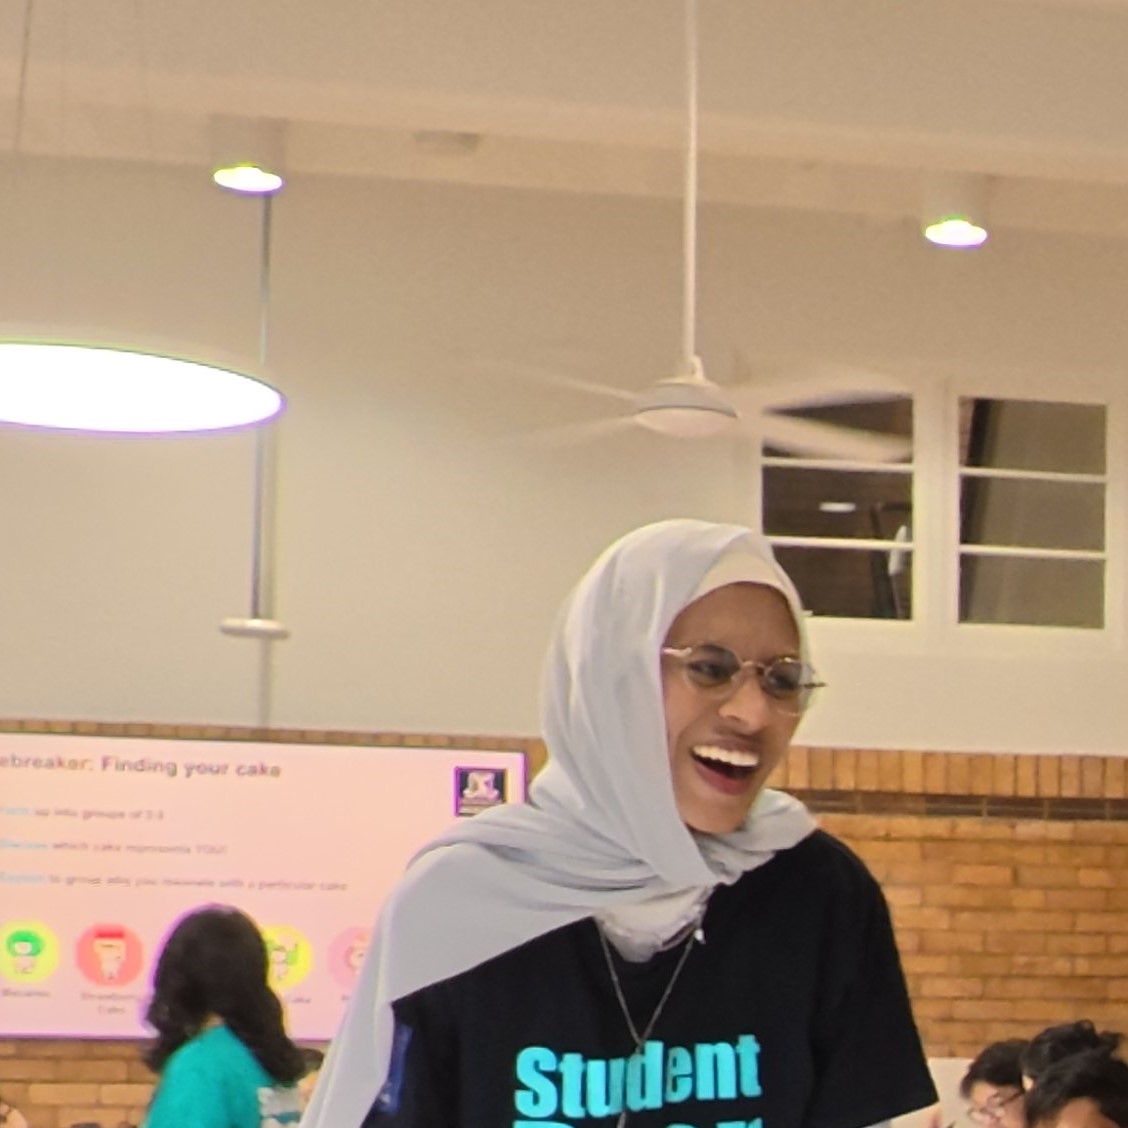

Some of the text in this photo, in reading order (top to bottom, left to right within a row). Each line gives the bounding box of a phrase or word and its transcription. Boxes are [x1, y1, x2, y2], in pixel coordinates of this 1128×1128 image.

[102, 755, 177, 777] Finding
[184, 762, 229, 778] your
[235, 761, 281, 778] cake
[513, 1034, 763, 1120] Student
